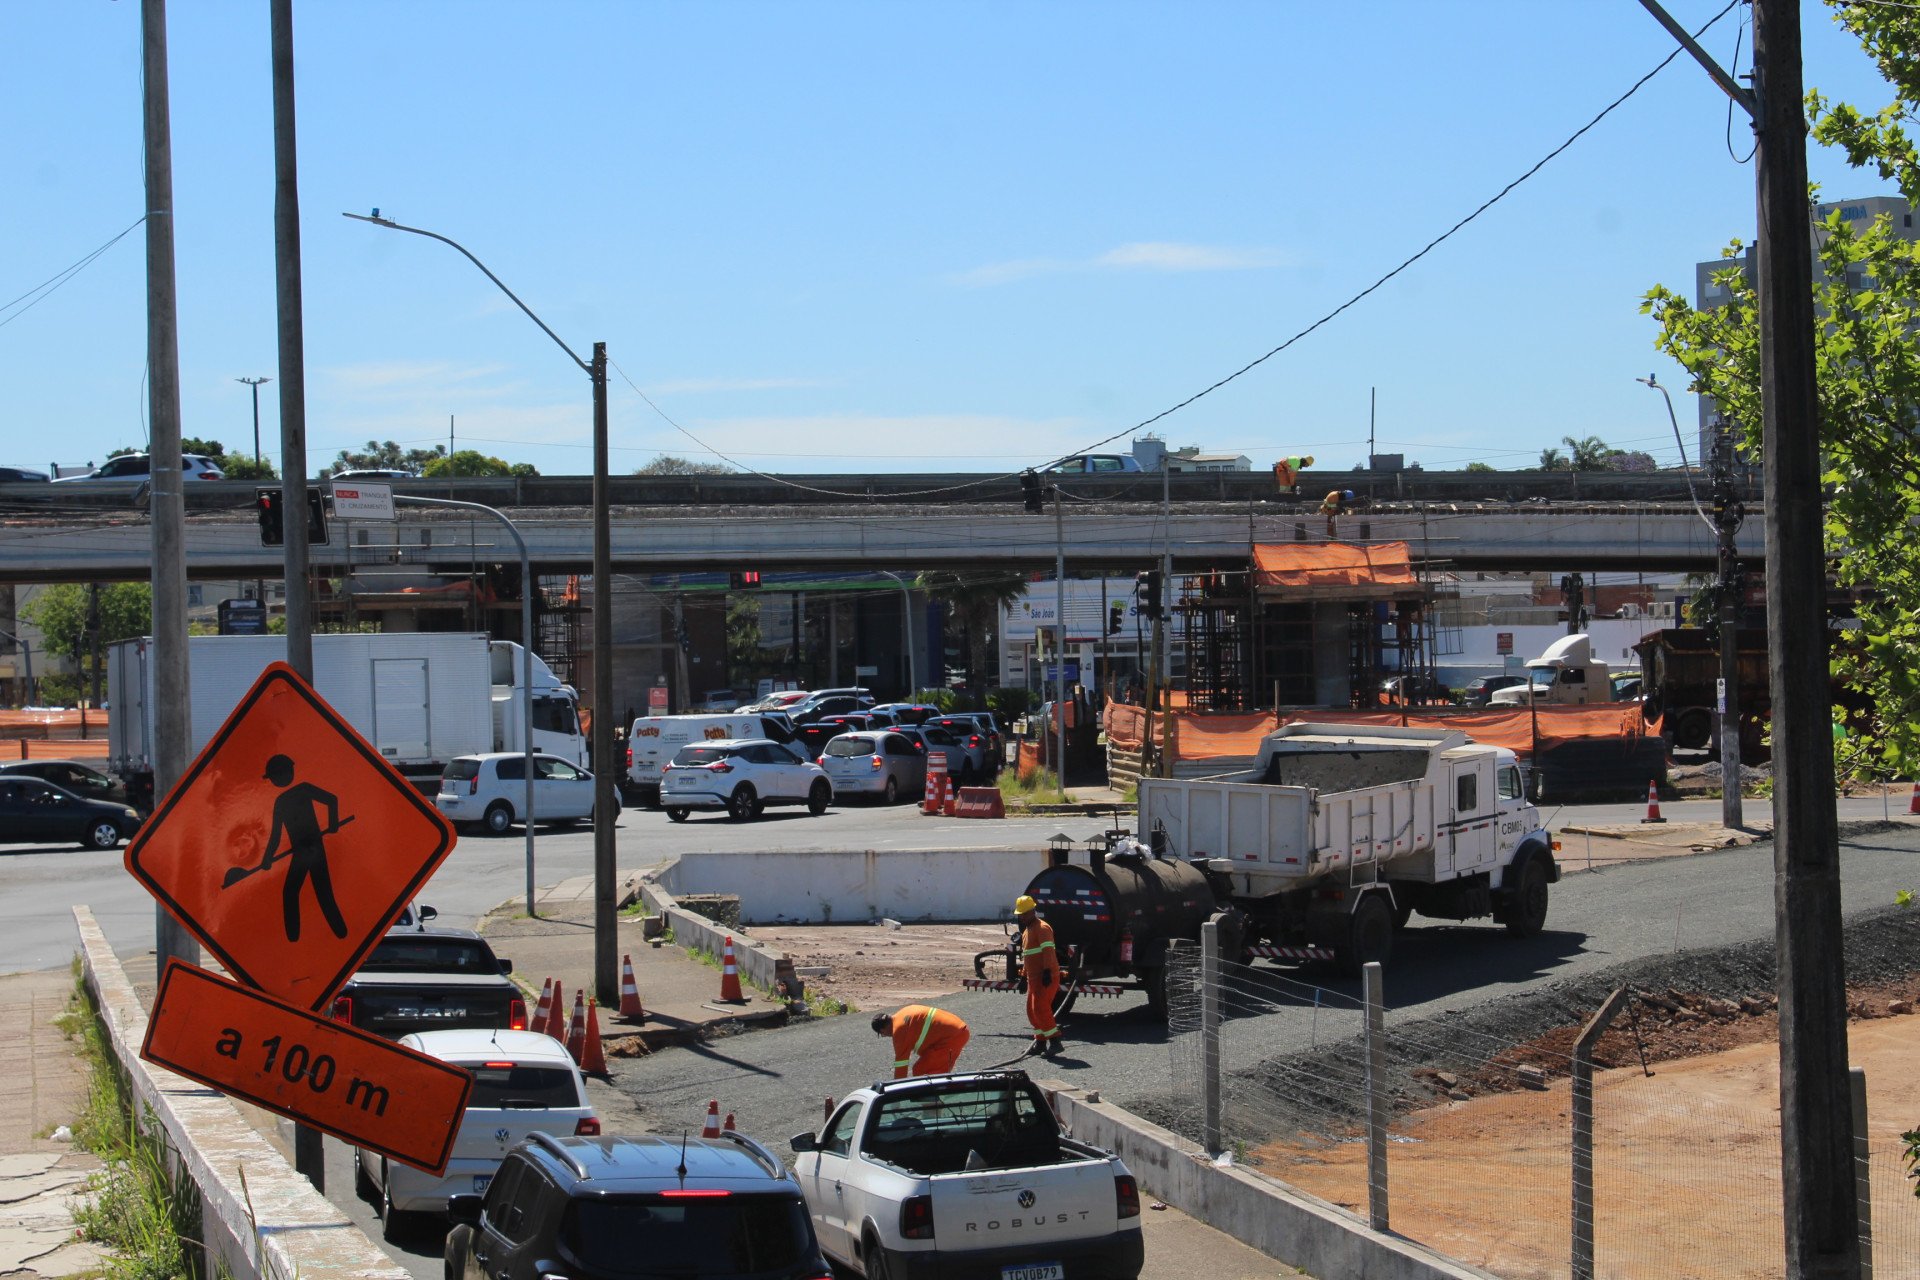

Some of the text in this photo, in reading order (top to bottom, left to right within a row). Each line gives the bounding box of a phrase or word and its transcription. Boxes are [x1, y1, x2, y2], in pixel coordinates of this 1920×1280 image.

[637, 727, 660, 738] Patty
[704, 727, 726, 739] Patty
[398, 1008, 467, 1017] RAM
[215, 1028, 390, 1117] a 100 m
[965, 1210, 1090, 1232] ROBUST
